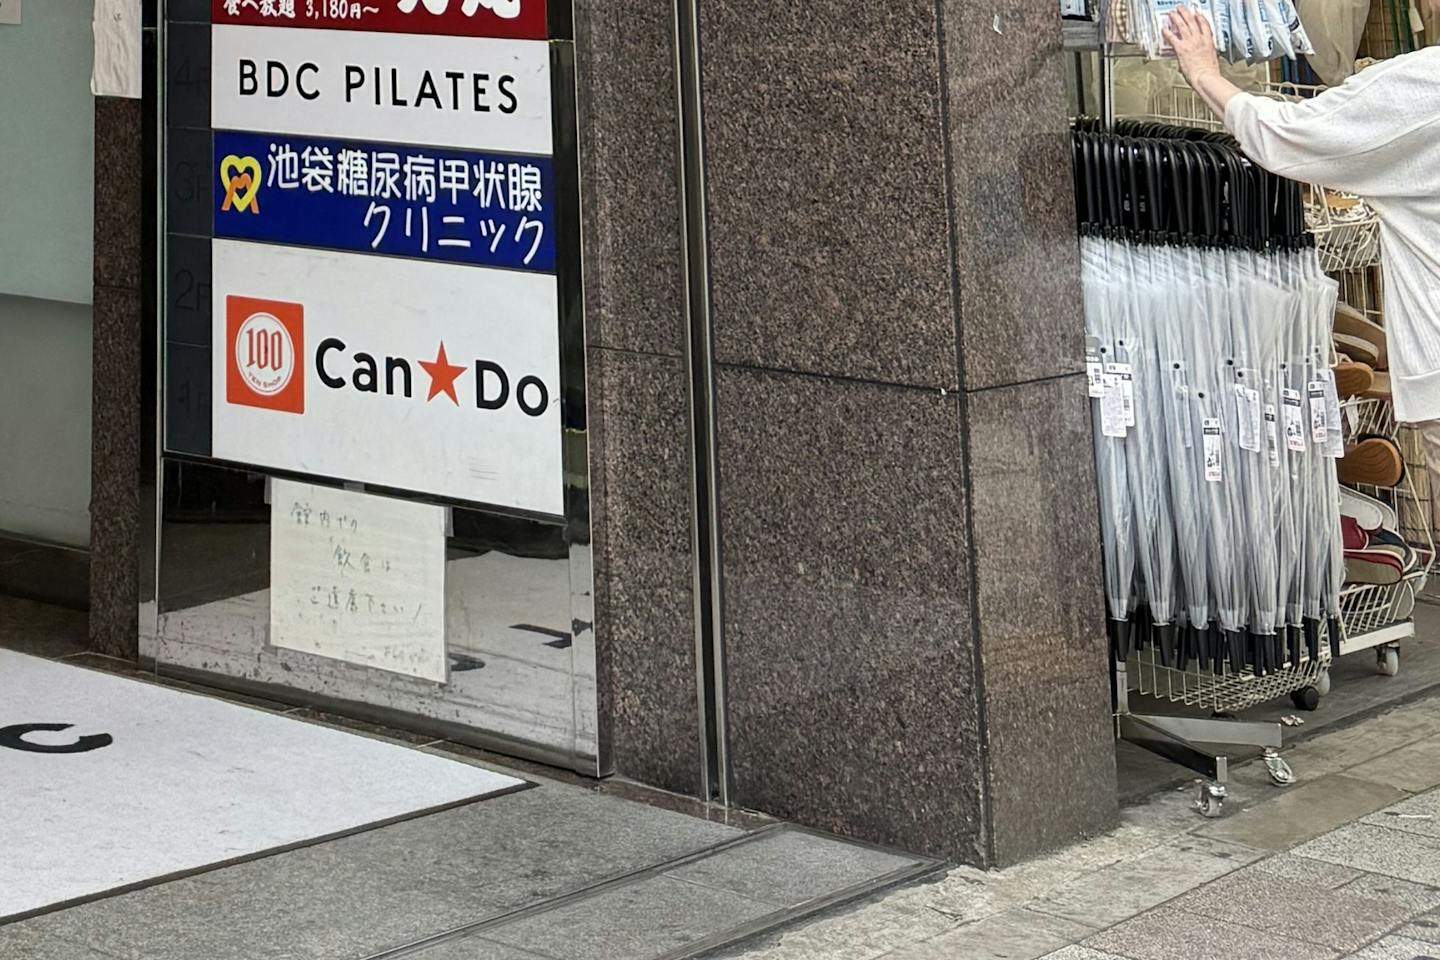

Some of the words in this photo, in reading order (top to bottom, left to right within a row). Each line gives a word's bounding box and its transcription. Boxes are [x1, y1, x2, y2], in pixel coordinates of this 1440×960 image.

[239, 59, 320, 100] BDC
[345, 65, 518, 114] PILATES
[267, 143, 543, 212] 池袋糖尿病甲状腺
[364, 202, 544, 265] クリニック
[246, 328, 282, 371] 100
[315, 338, 412, 398] Can
[475, 360, 549, 417] Do
